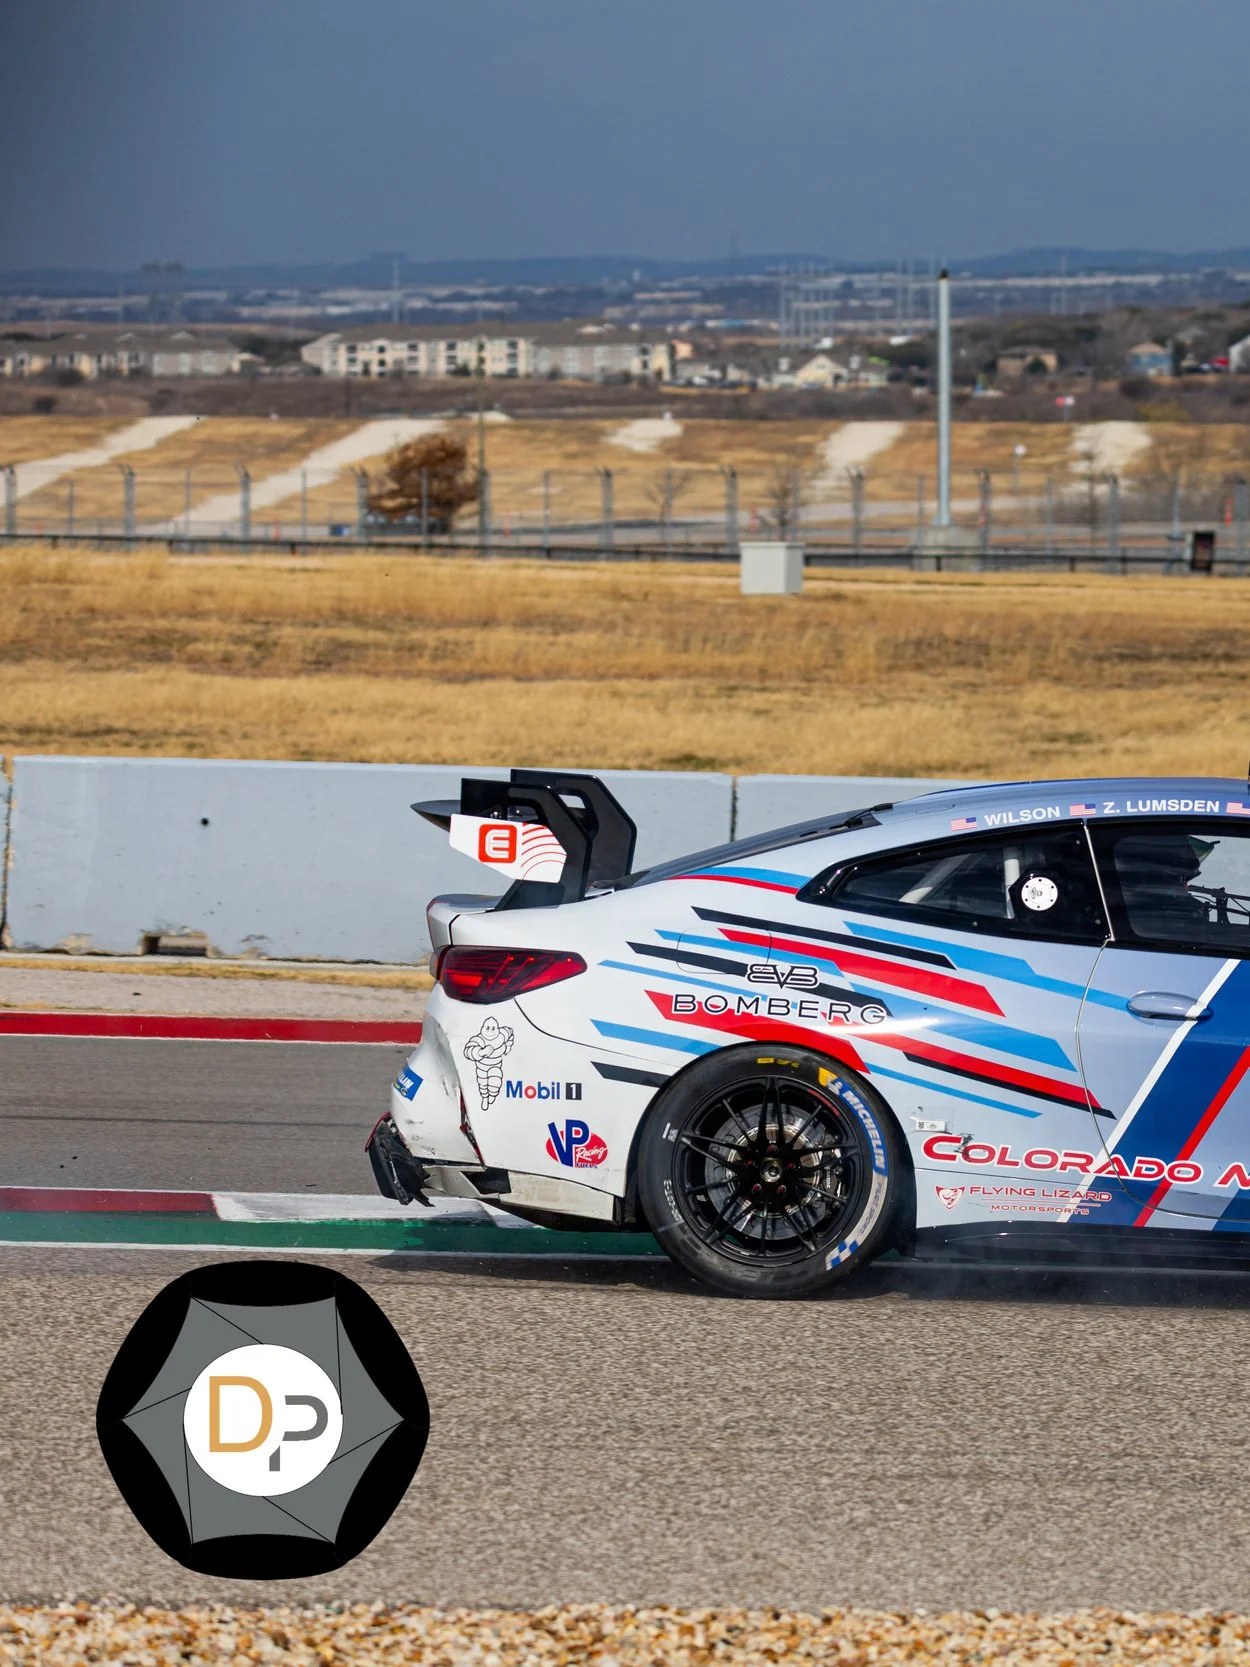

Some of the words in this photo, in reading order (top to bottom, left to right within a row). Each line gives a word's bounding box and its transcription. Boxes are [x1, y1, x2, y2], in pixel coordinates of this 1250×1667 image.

[984, 806, 1061, 826] WILSON
[1103, 802, 1120, 814] Z.
[1126, 800, 1219, 813] LUMSDEN
[672, 994, 886, 1025] BOMBERG
[506, 1080, 560, 1100] Mobil
[843, 1089, 886, 1169] MICHELIN
[548, 1119, 590, 1167] VP
[969, 1186, 1036, 1197] FLYING
[1049, 1189, 1112, 1201] LIZARD
[991, 1205, 1089, 1215] MOTORSPORTS
